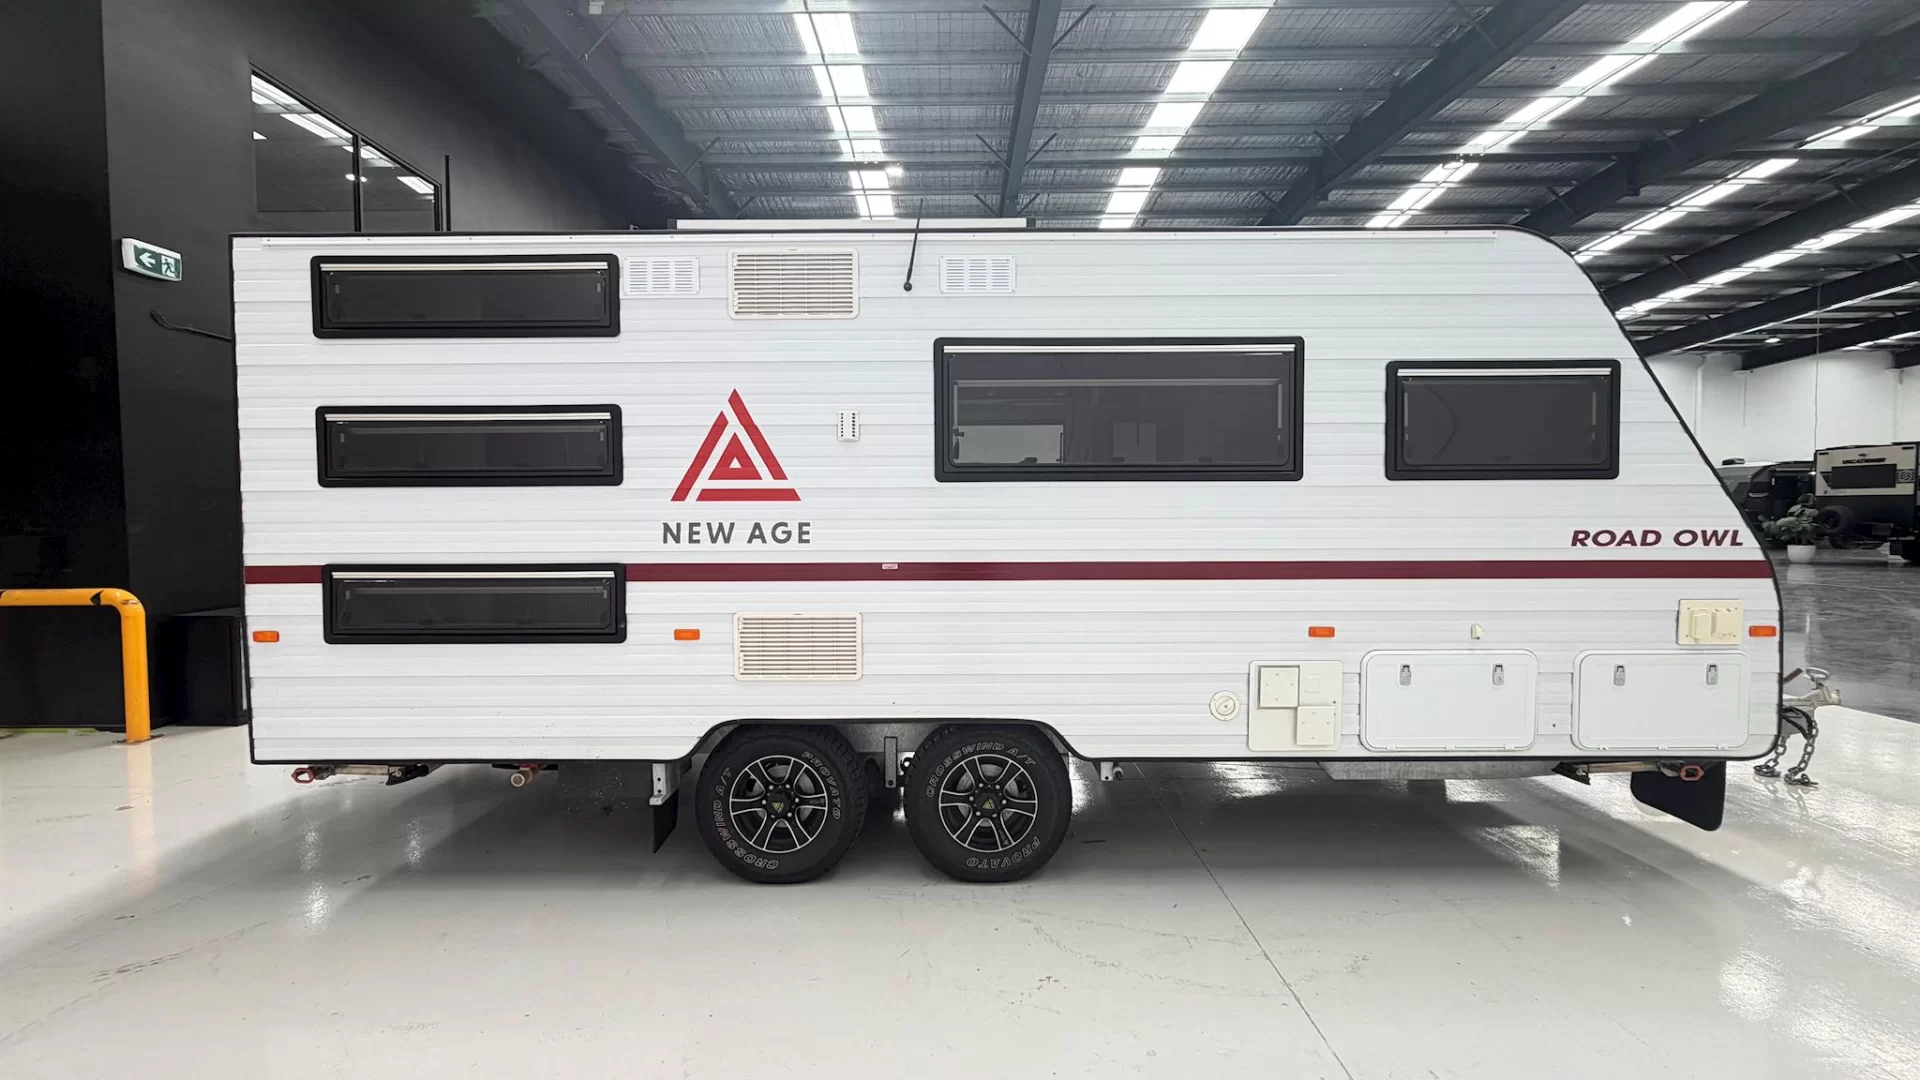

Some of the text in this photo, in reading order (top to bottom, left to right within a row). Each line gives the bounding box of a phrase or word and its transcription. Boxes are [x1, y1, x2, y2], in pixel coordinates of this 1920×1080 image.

[662, 522, 811, 544] NEW AGE
[1570, 529, 1744, 547] ROAD OWL
[801, 751, 842, 820] PROVATO
[926, 741, 1037, 798] CROSSWIND A/T
[712, 766, 779, 870] CROSSWIND A/T
[966, 836, 1041, 869] PROVATO
